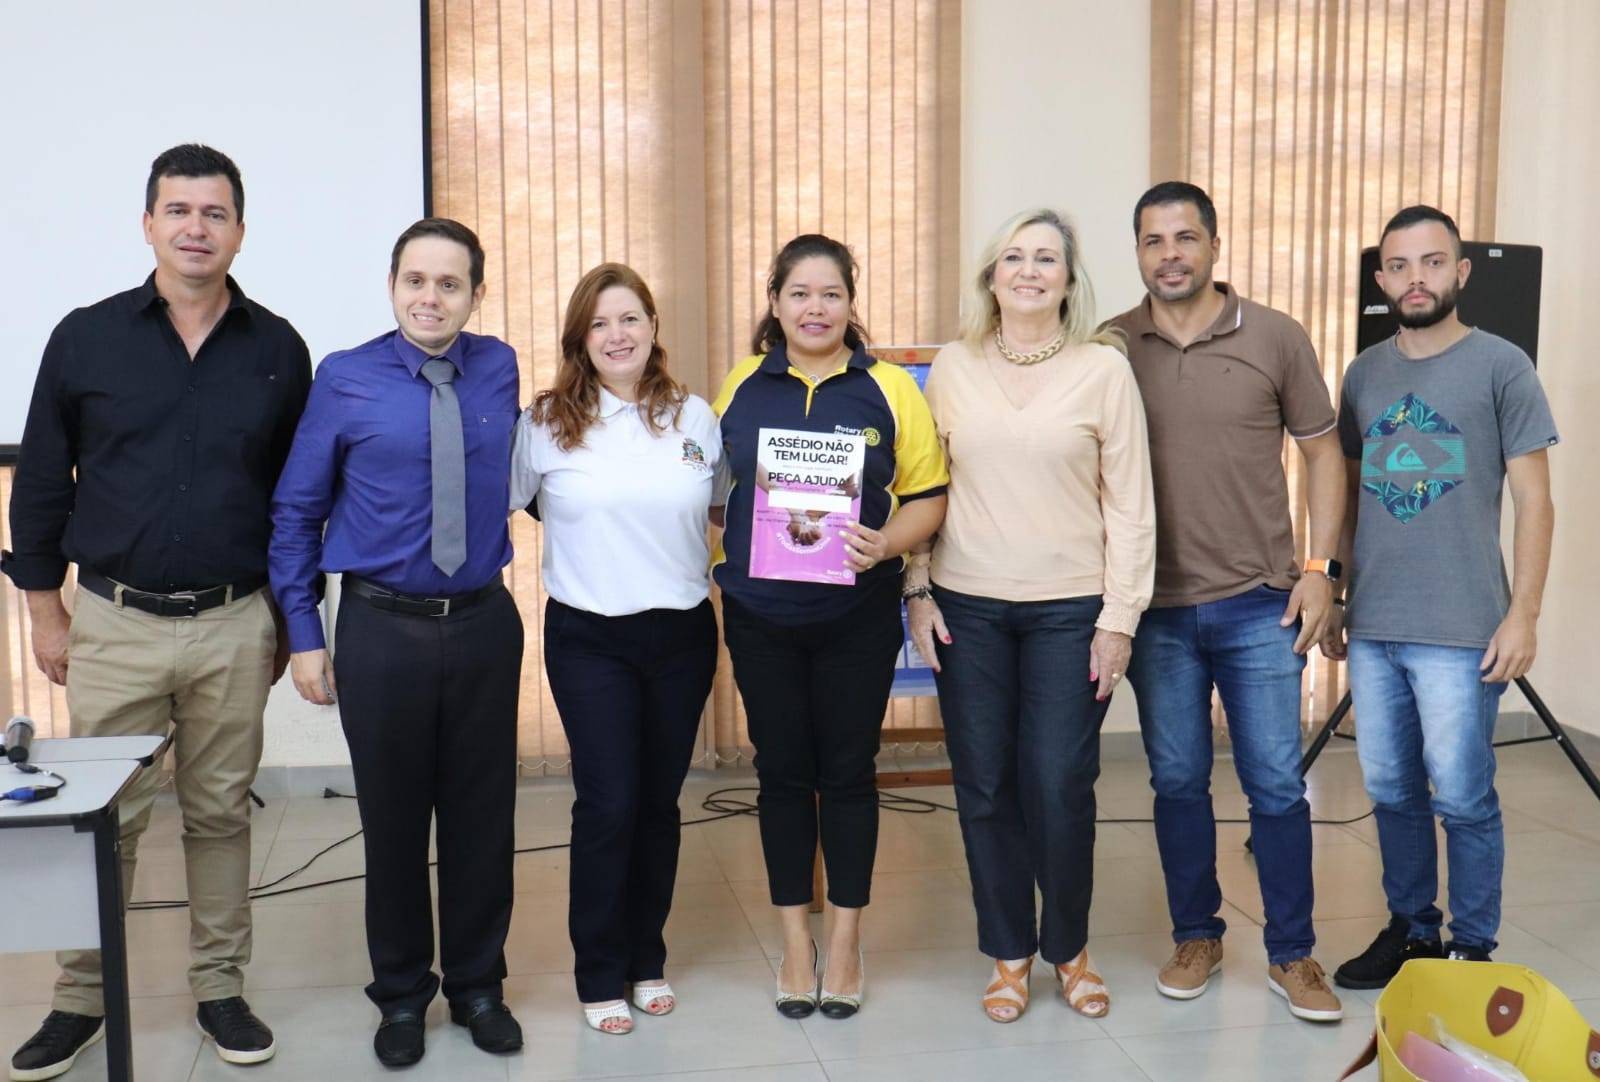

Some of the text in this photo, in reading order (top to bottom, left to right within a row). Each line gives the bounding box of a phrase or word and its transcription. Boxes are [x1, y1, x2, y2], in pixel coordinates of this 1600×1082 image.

[835, 424, 861, 436] Rotary
[768, 436, 854, 453] ASSÉDIO NÃO
[774, 450, 848, 466] TEM LUGAR!
[768, 472, 801, 486] PEÇA
